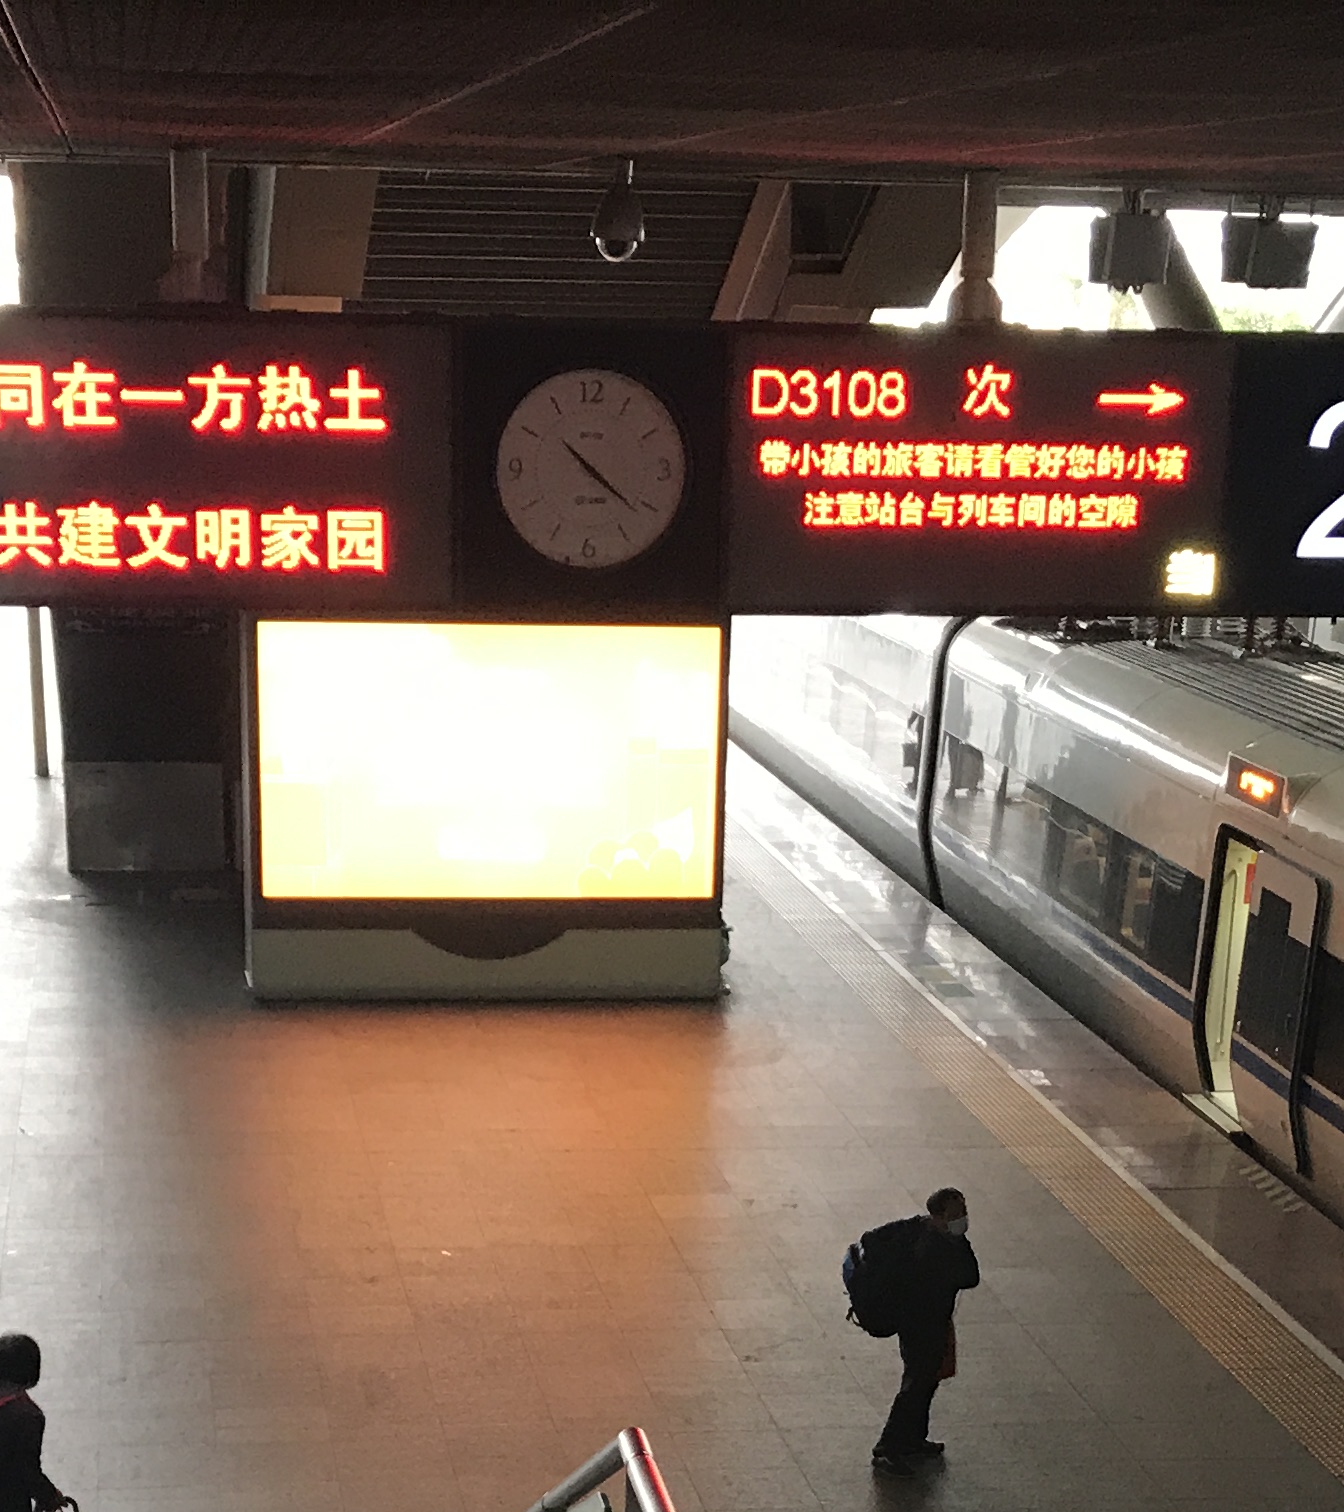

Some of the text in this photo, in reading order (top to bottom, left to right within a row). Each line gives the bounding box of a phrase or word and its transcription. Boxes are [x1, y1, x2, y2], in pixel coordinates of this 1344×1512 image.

[580, 379, 604, 404] 12
[750, 364, 1014, 421] D3108 次
[508, 457, 523, 481] 9
[656, 458, 672, 481] 3
[758, 438, 1189, 484] 带小孩的旅客请看管好您的小孩
[803, 487, 1140, 532] 注意站台与列车间的空隙
[582, 538, 596, 558] 6
